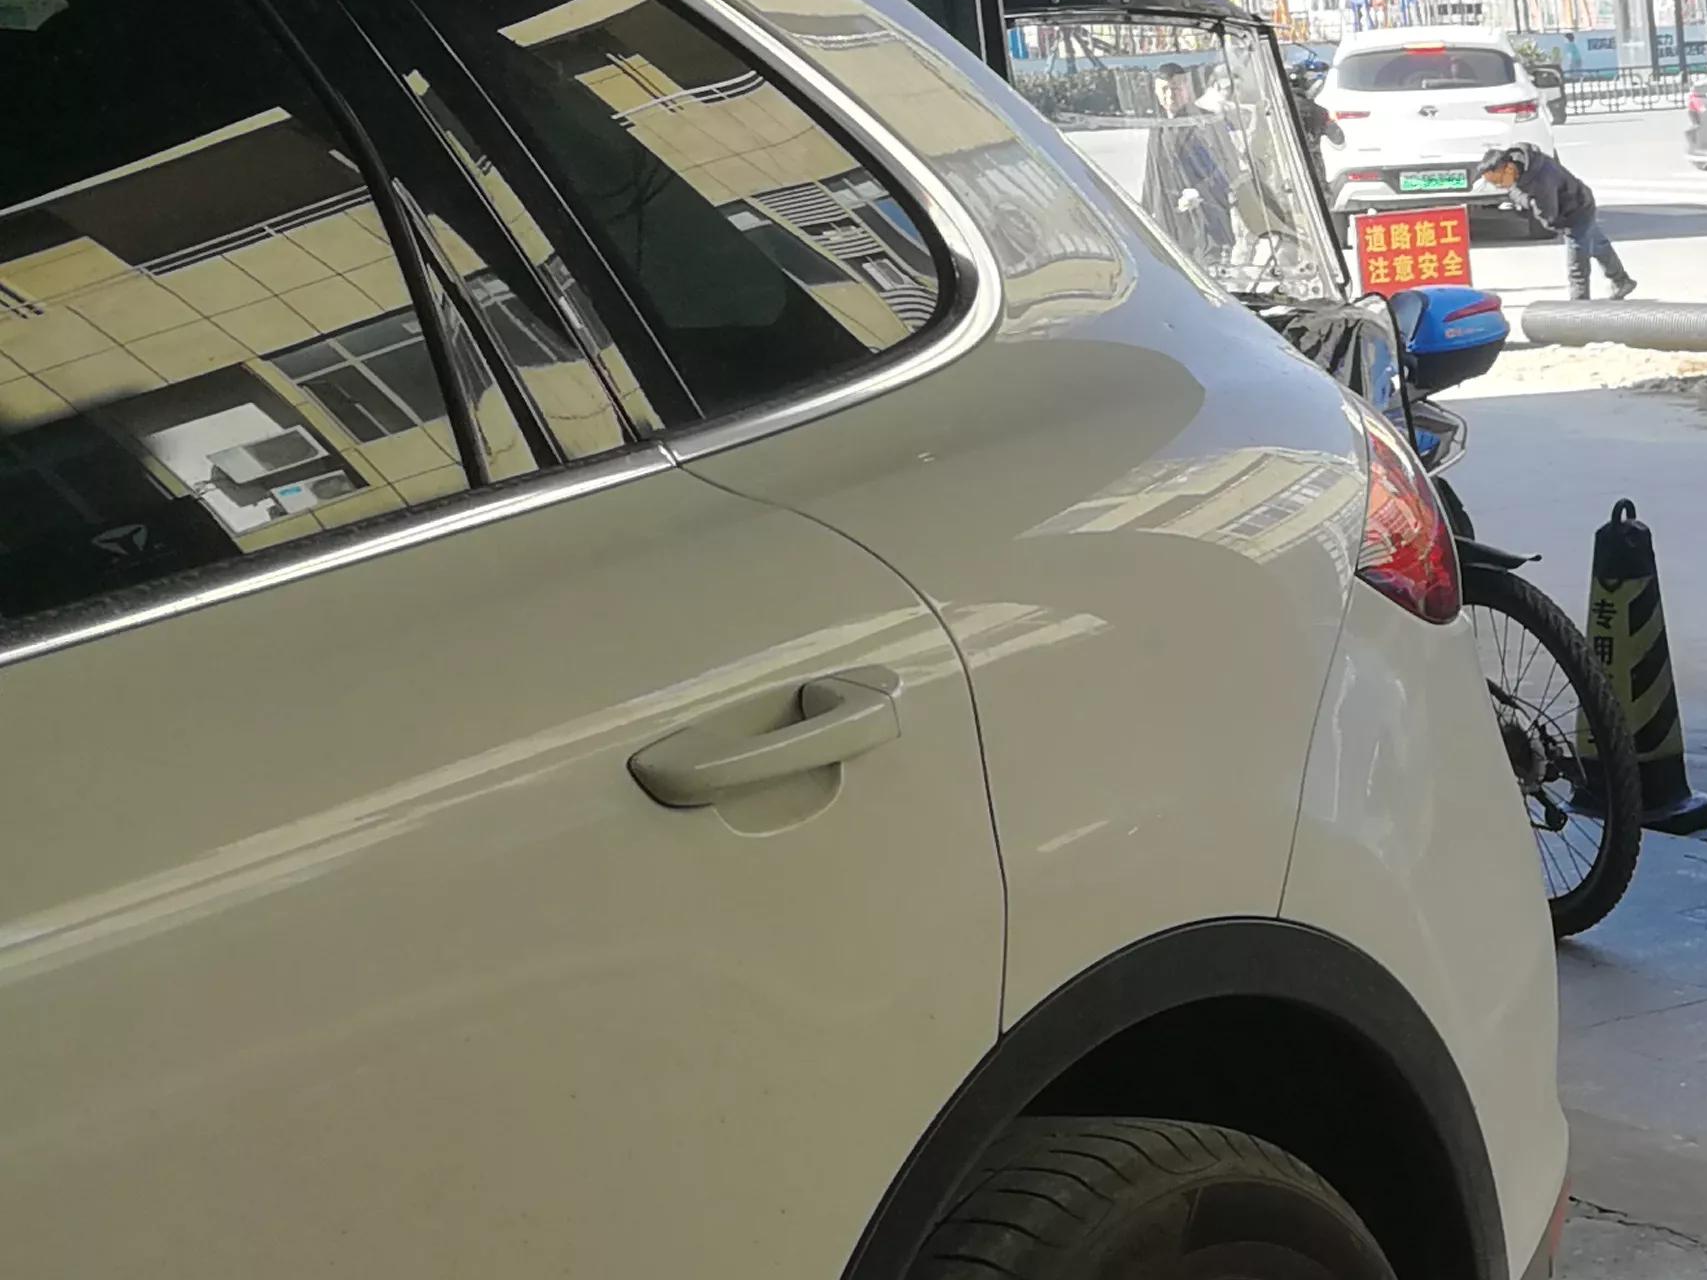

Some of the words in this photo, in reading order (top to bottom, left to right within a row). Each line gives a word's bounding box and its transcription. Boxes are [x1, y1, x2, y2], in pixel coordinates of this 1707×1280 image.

[1364, 219, 1462, 253] 道路施工
[1368, 250, 1464, 285] 注意安全
